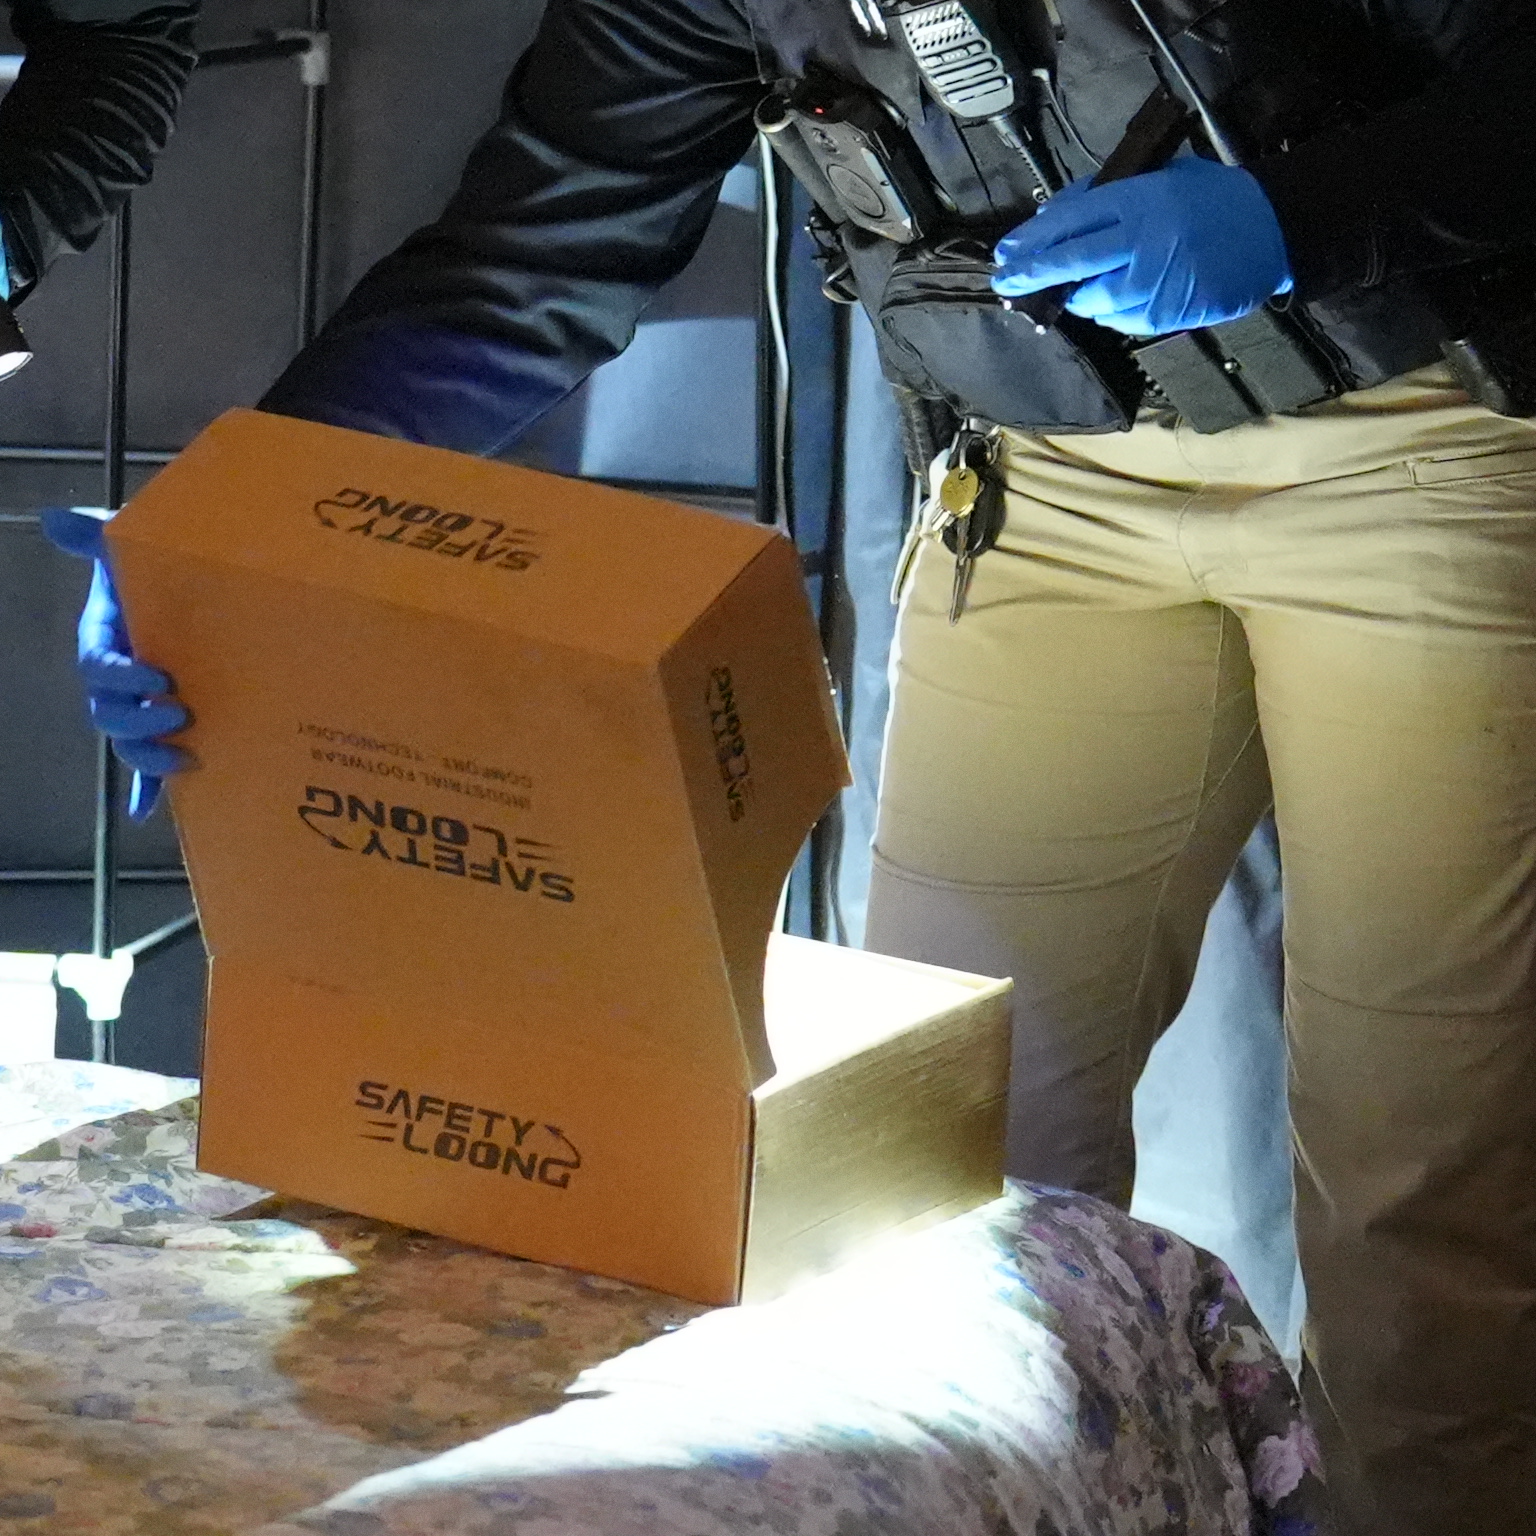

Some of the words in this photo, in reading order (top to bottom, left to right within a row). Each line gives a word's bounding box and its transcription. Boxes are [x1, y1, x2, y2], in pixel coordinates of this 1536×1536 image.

[314, 487, 505, 541] LOONG
[348, 517, 541, 571] SAFETY
[310, 747, 416, 782] FOOTWEAR
[297, 785, 508, 858] LOONG
[361, 828, 576, 903] SAFETY
[355, 1080, 535, 1147] SAFETY
[402, 1122, 581, 1189] LOONG
